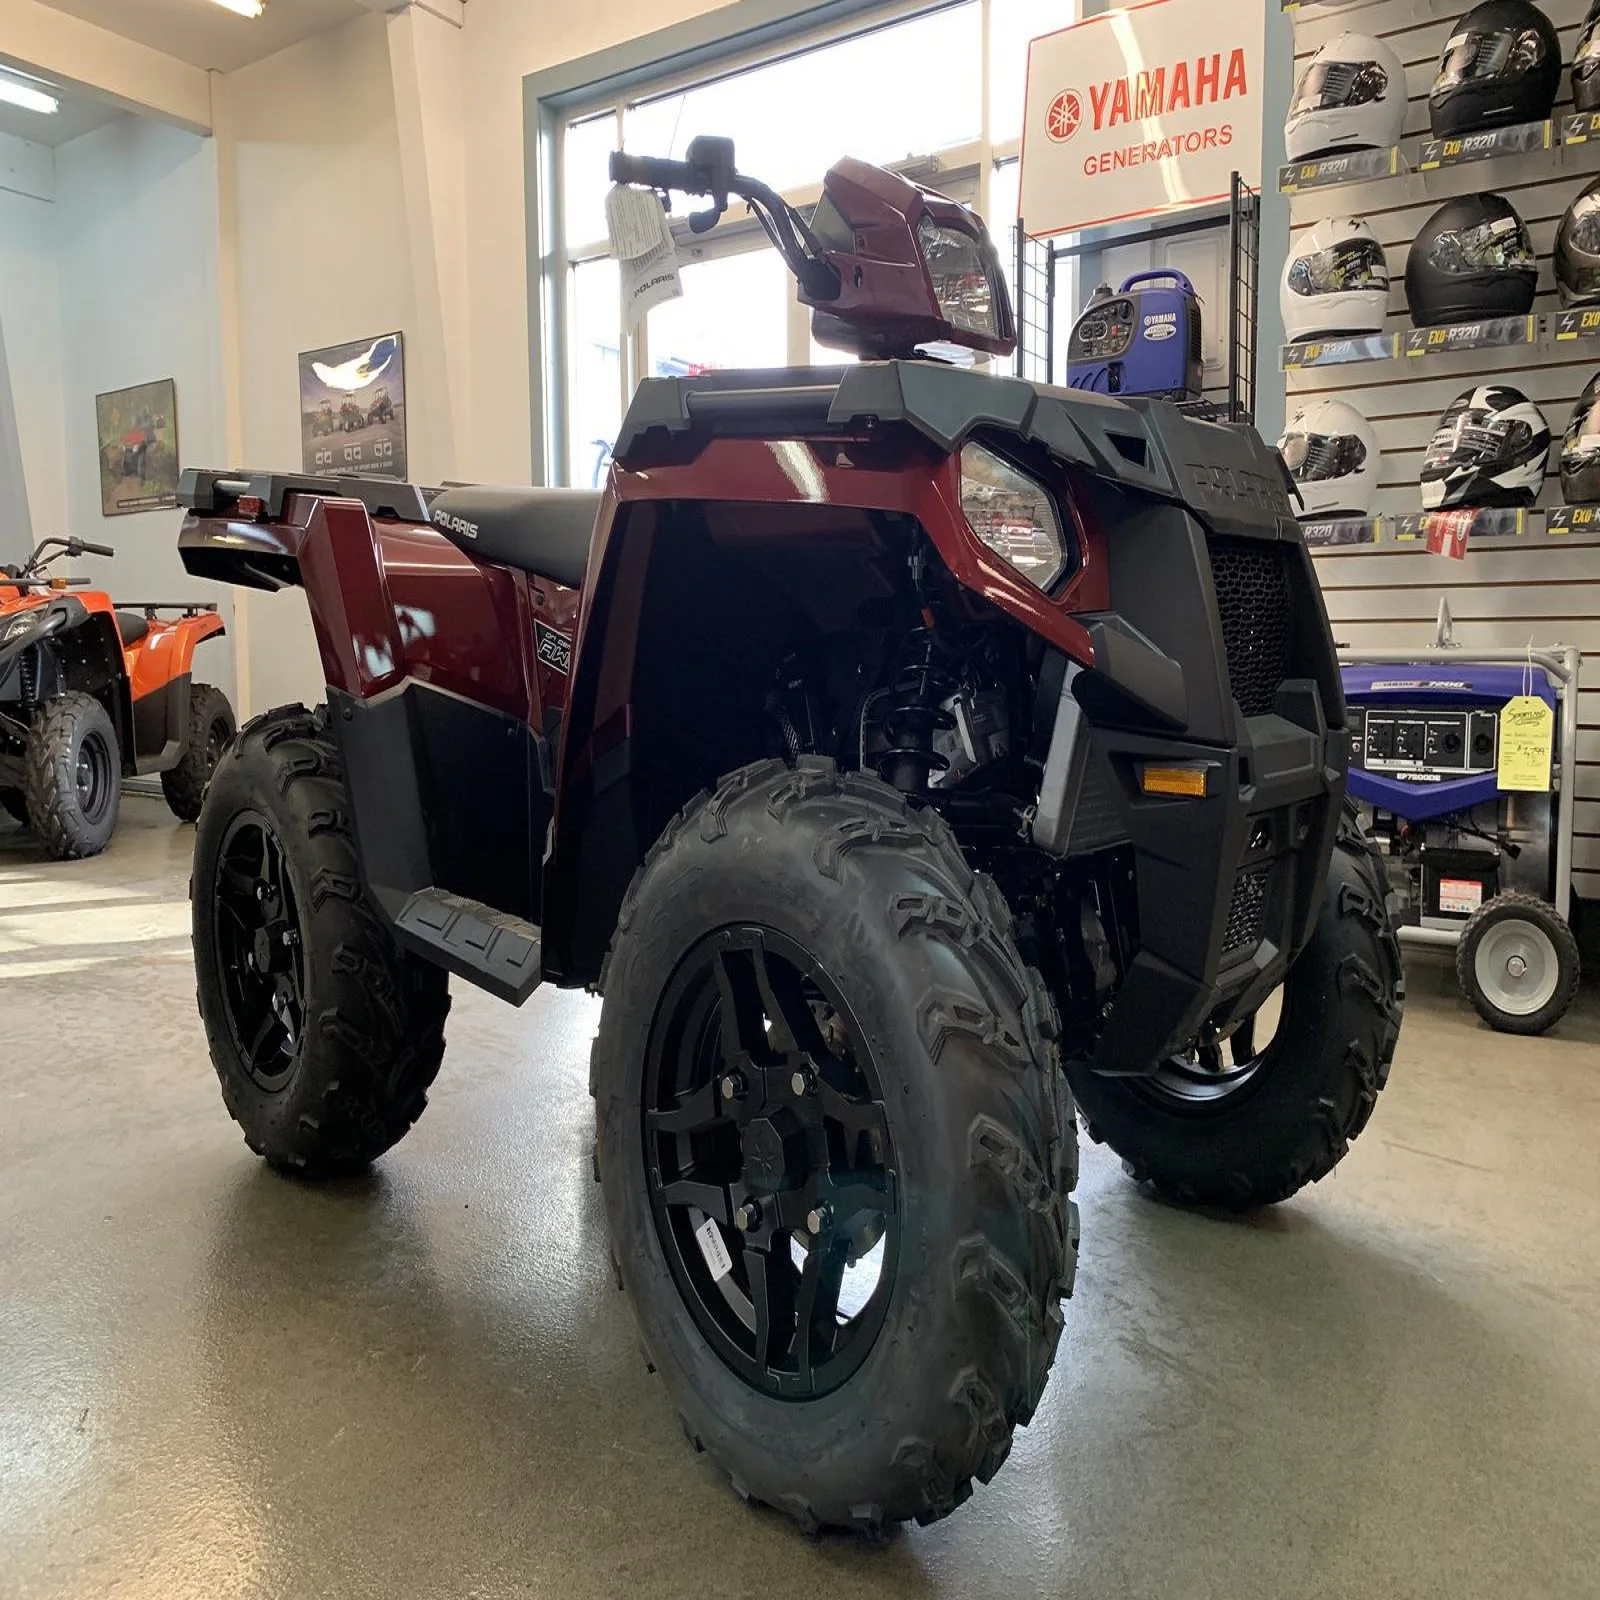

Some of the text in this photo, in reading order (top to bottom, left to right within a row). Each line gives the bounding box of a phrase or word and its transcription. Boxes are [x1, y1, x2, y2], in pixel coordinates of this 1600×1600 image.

[1089, 48, 1247, 130] YAMAHA
[1083, 124, 1233, 176] GENERATORS
[634, 273, 674, 298] POLARIS
[1151, 312, 1176, 325] YAMAHA
[433, 509, 479, 539] POLARIS
[539, 638, 571, 669] AW
